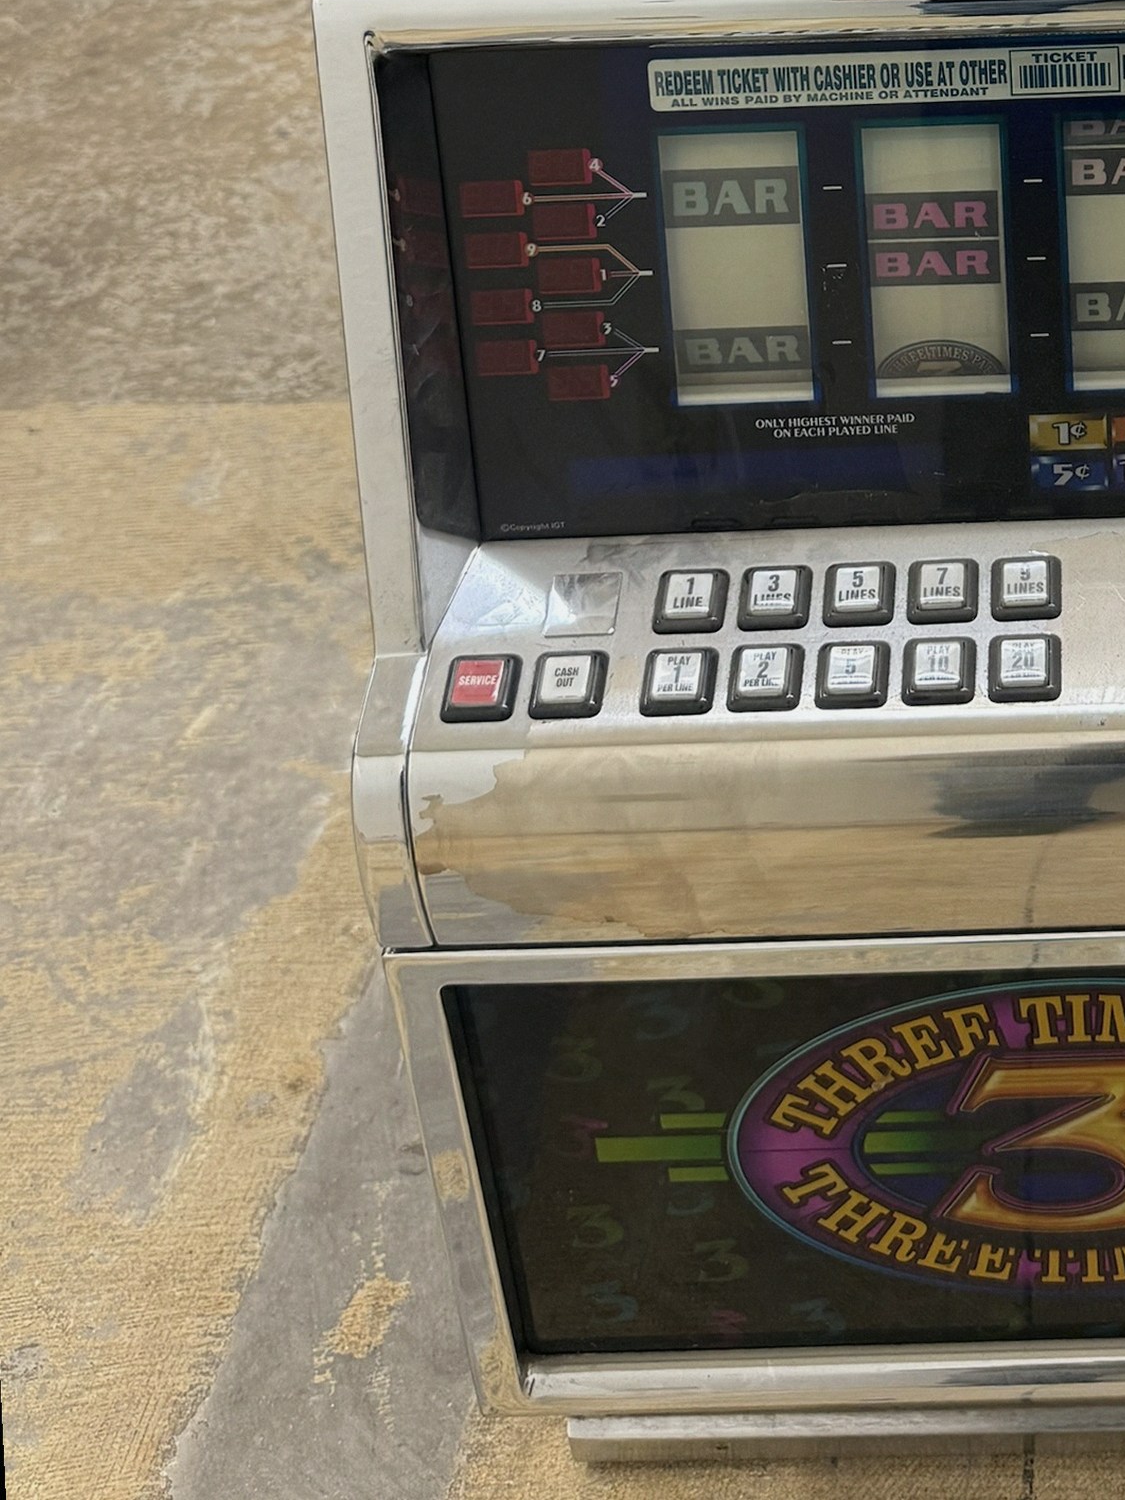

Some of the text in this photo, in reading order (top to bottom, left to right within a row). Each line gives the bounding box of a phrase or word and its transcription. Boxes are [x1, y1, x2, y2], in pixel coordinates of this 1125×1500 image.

[655, 69, 714, 96] REDEEM
[717, 67, 769, 94] TICKET
[772, 66, 810, 93] WITH
[813, 63, 877, 91] CASHIER
[880, 62, 900, 89] OR
[904, 61, 933, 88] USE
[937, 60, 958, 86] AT
[959, 59, 1008, 86] OTHER
[1032, 51, 1097, 64] TICKET
[755, 413, 915, 429] ONLY HIGHEST WINNER PAID
[773, 424, 899, 439] ON EACH PLAYED LINE
[554, 667, 579, 677] CASH
[459, 675, 497, 686] SERVICE
[556, 677, 574, 688] OUT
[772, 1000, 999, 1137] THREE
[783, 1162, 1012, 1281] THREE
